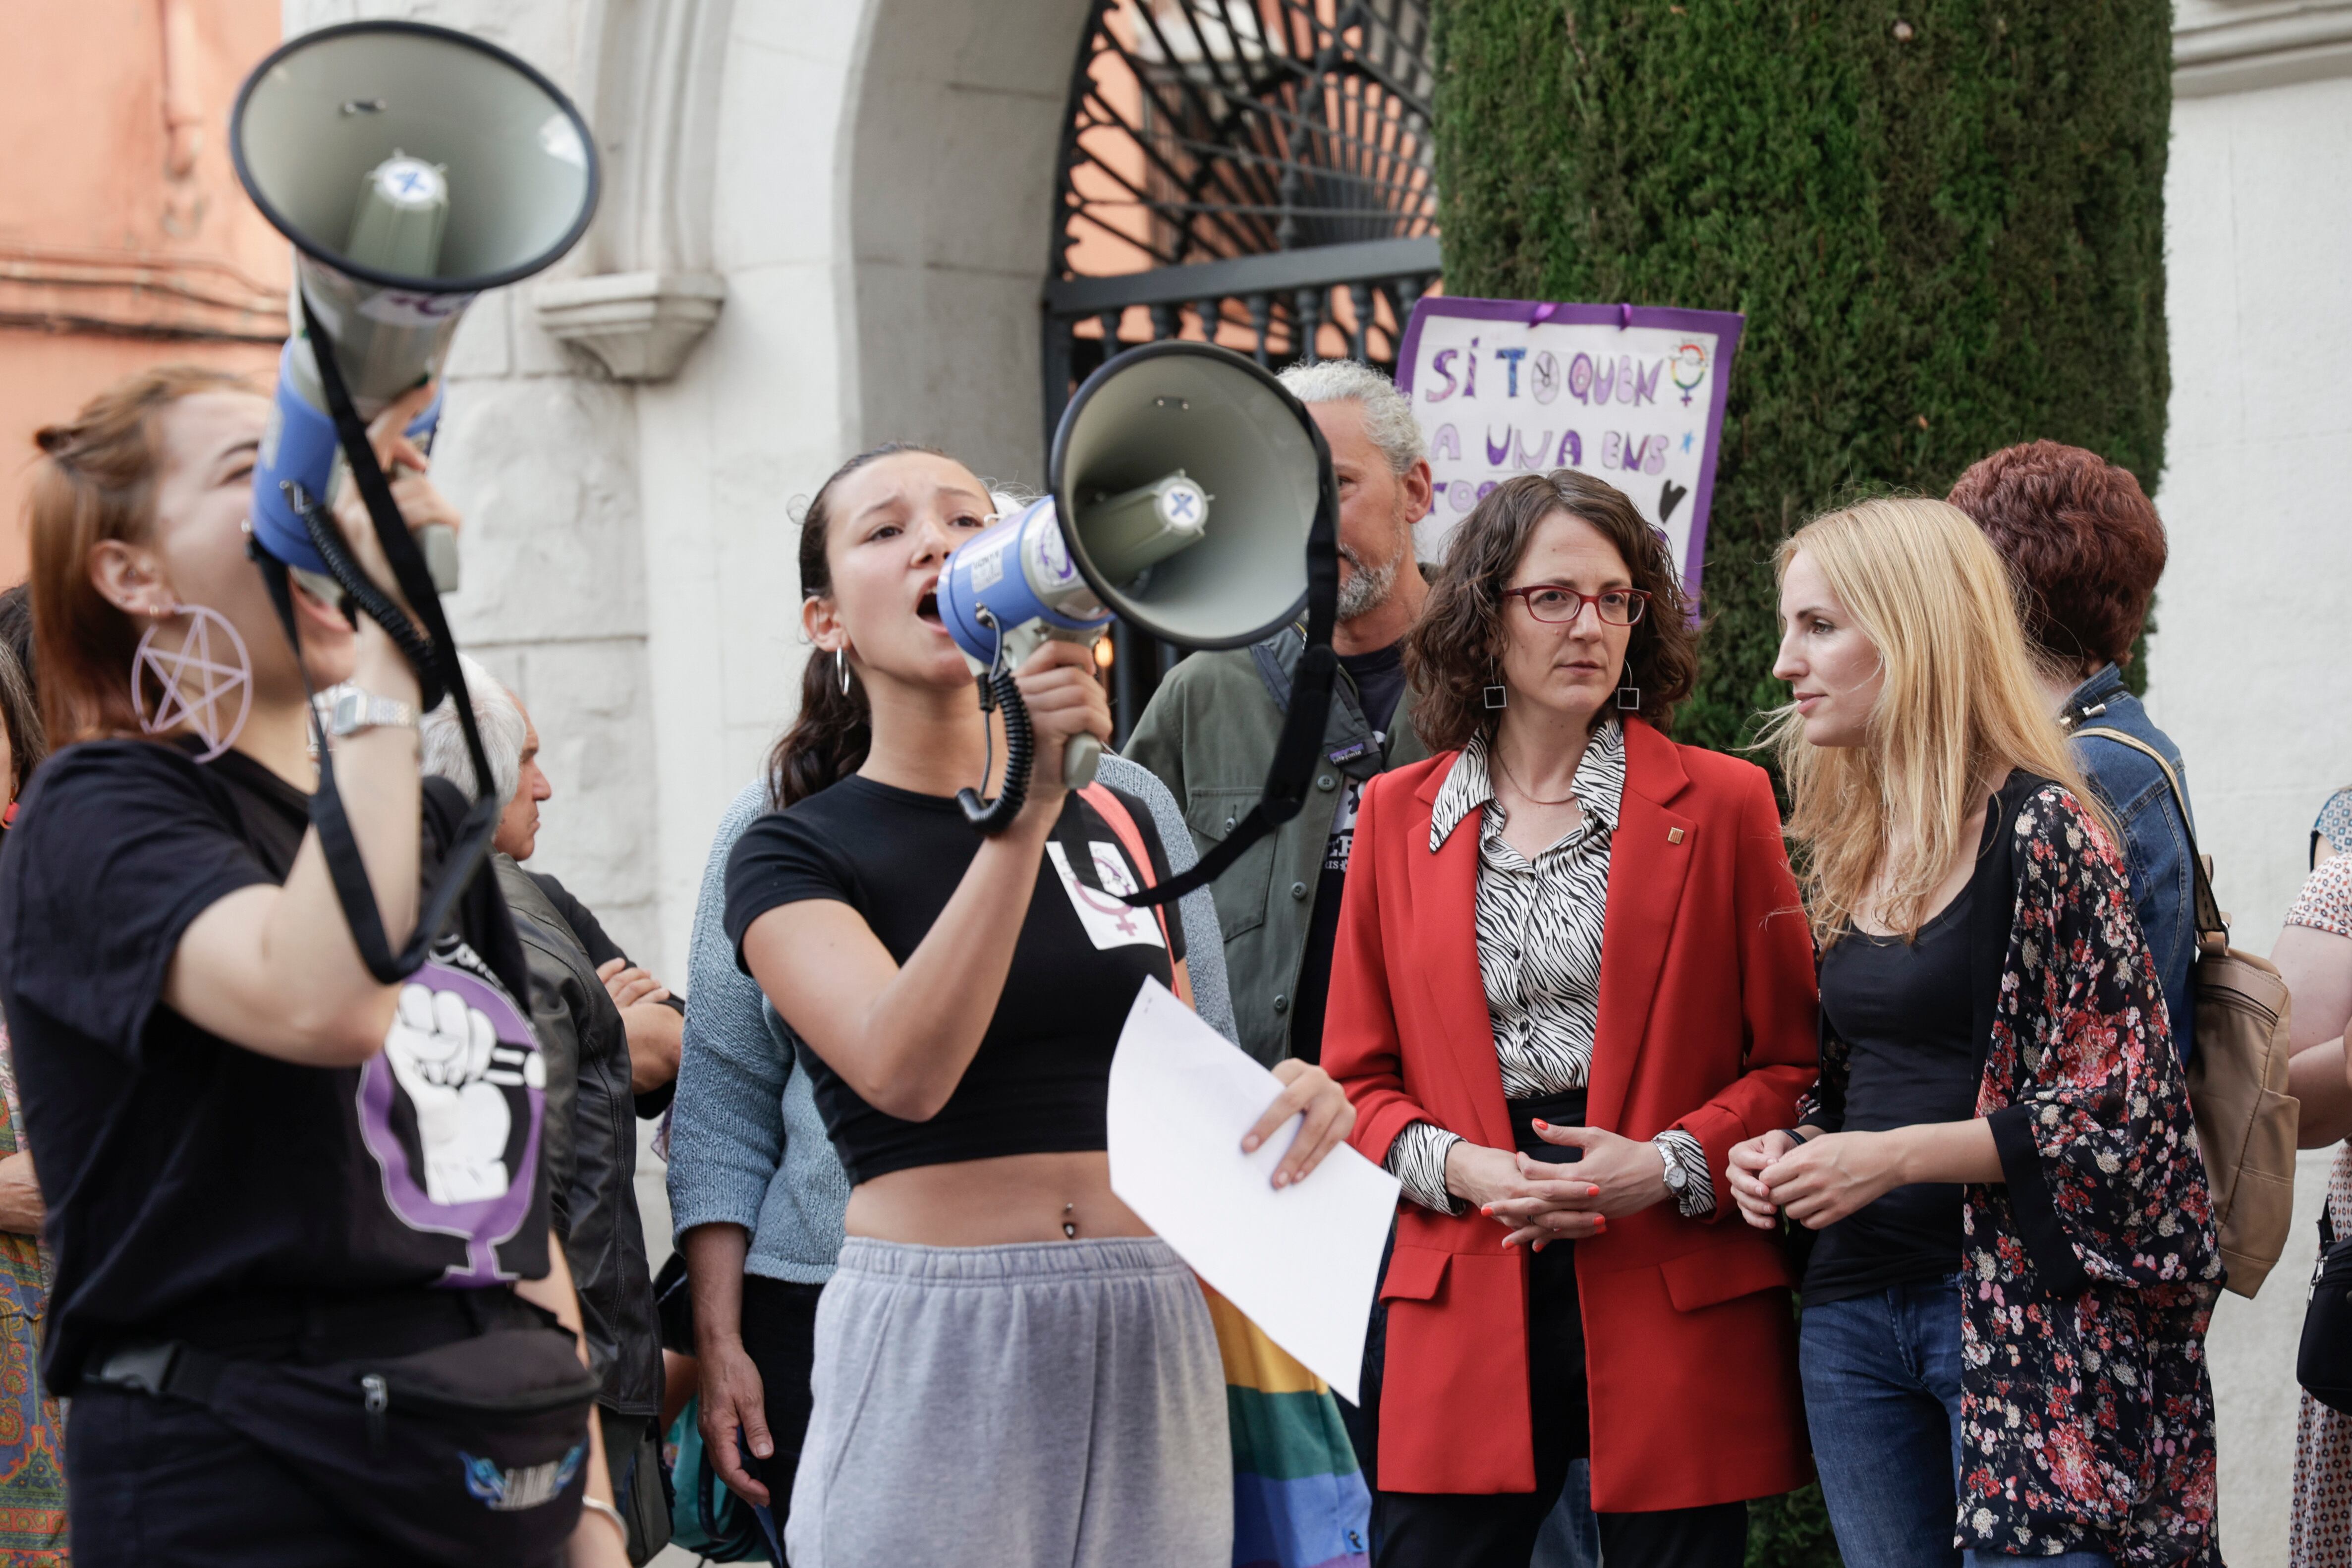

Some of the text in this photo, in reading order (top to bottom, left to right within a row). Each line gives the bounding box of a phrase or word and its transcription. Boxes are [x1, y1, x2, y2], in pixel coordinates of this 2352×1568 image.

[1495, 346, 1664, 407] TOQUEN
[1430, 423, 1670, 475] A UNA ENS
